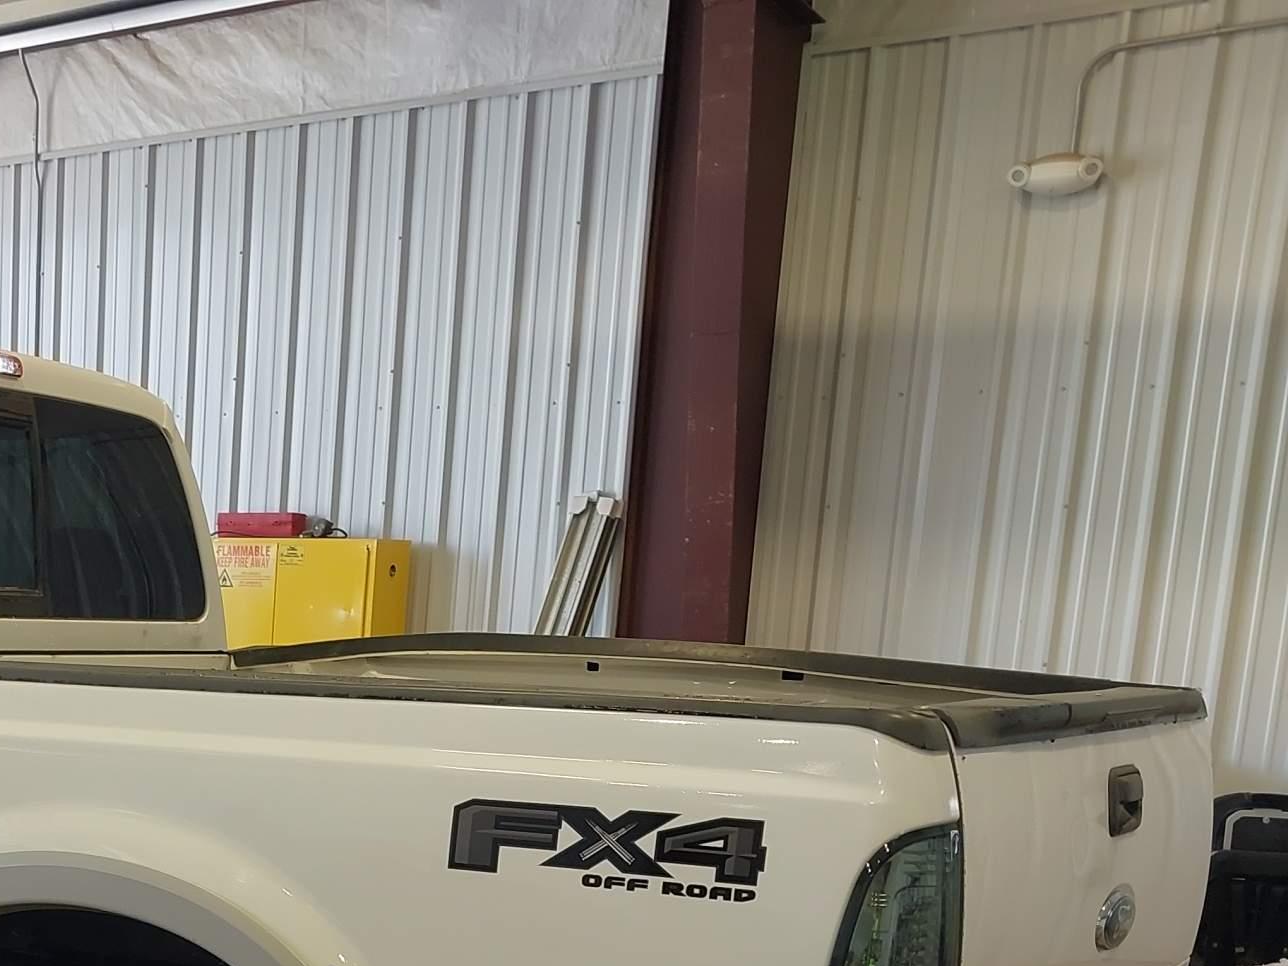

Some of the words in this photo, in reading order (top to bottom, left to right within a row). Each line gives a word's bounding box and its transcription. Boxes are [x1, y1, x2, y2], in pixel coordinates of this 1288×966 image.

[216, 545, 271, 557] FLAMMABLE
[217, 556, 232, 568] KEEP
[233, 557, 249, 568] FIRE
[250, 557, 270, 569] AWAY
[448, 798, 767, 886] FX4
[581, 874, 649, 892] OFF
[661, 881, 757, 902] ROAD
